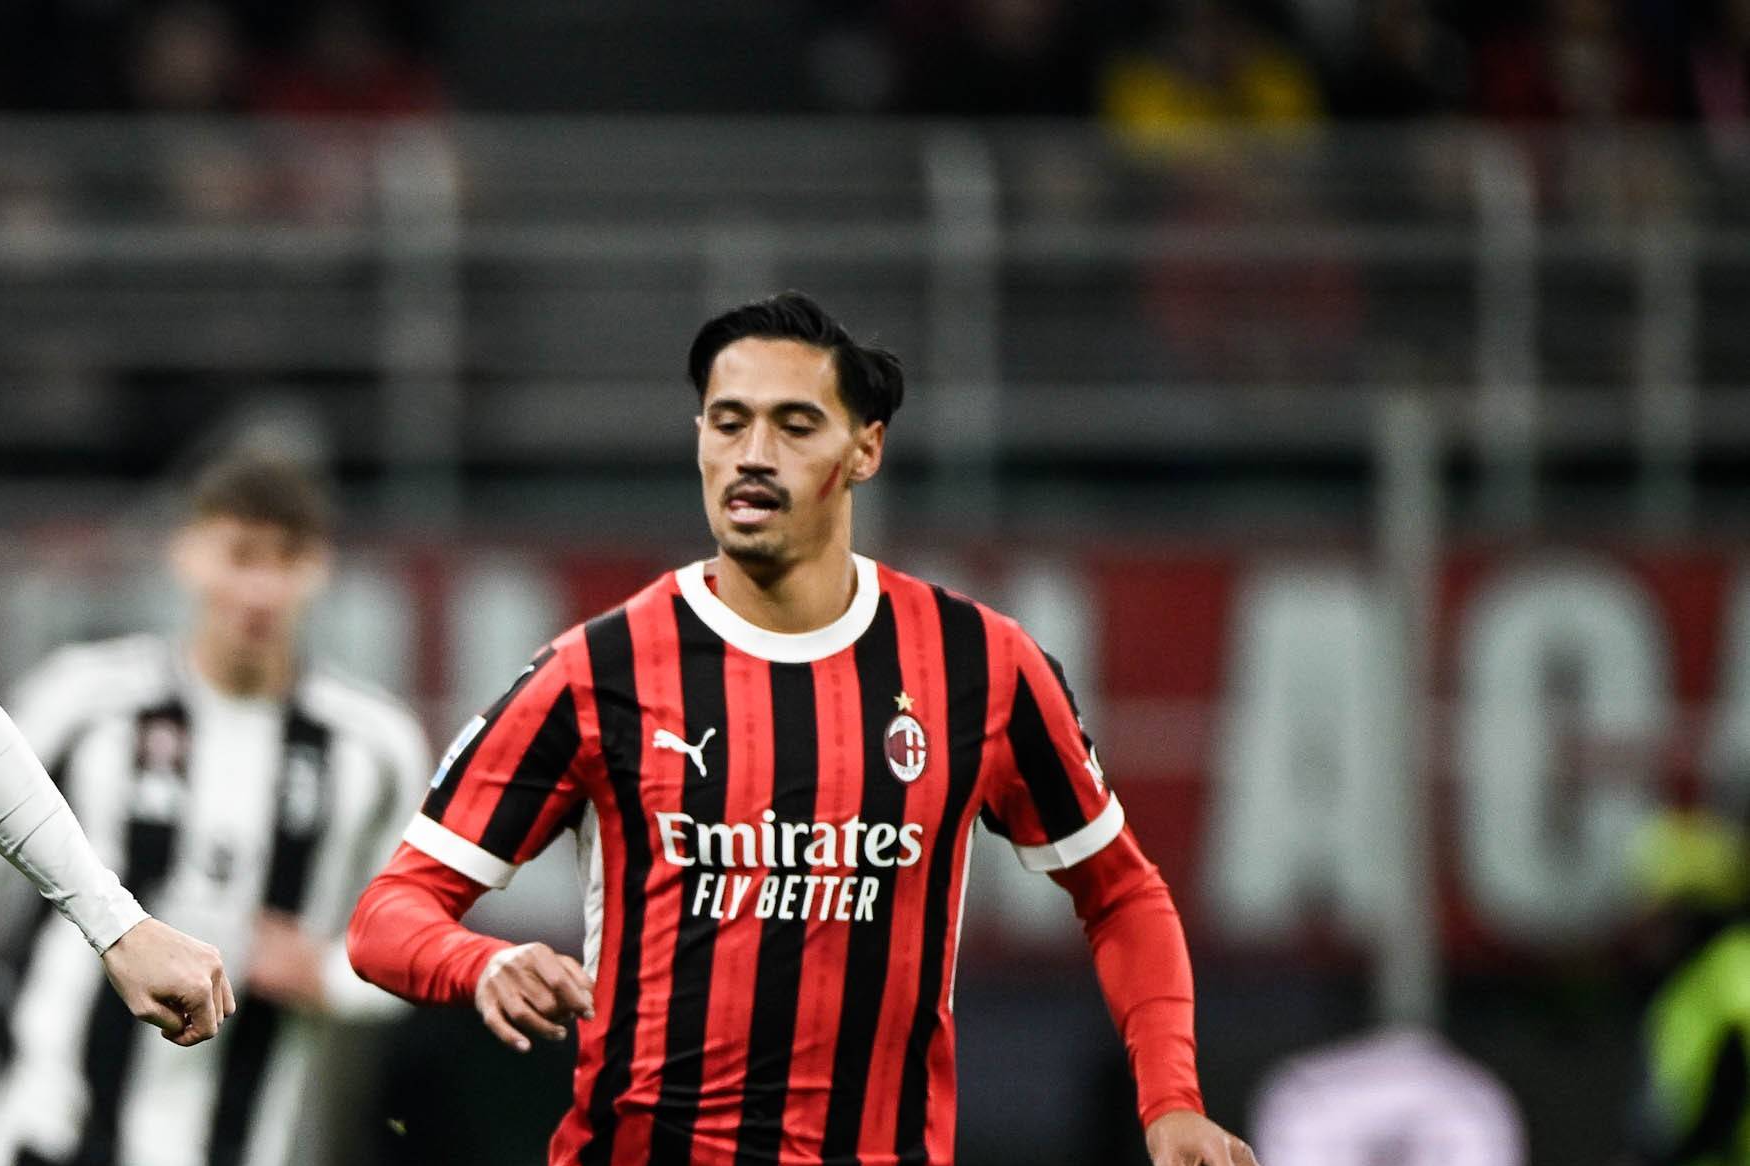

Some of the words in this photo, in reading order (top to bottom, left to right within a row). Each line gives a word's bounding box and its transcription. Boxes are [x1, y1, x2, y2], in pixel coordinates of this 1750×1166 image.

[655, 808, 923, 868] Emirates
[691, 872, 752, 920] FLY
[754, 874, 880, 921] BETTER
